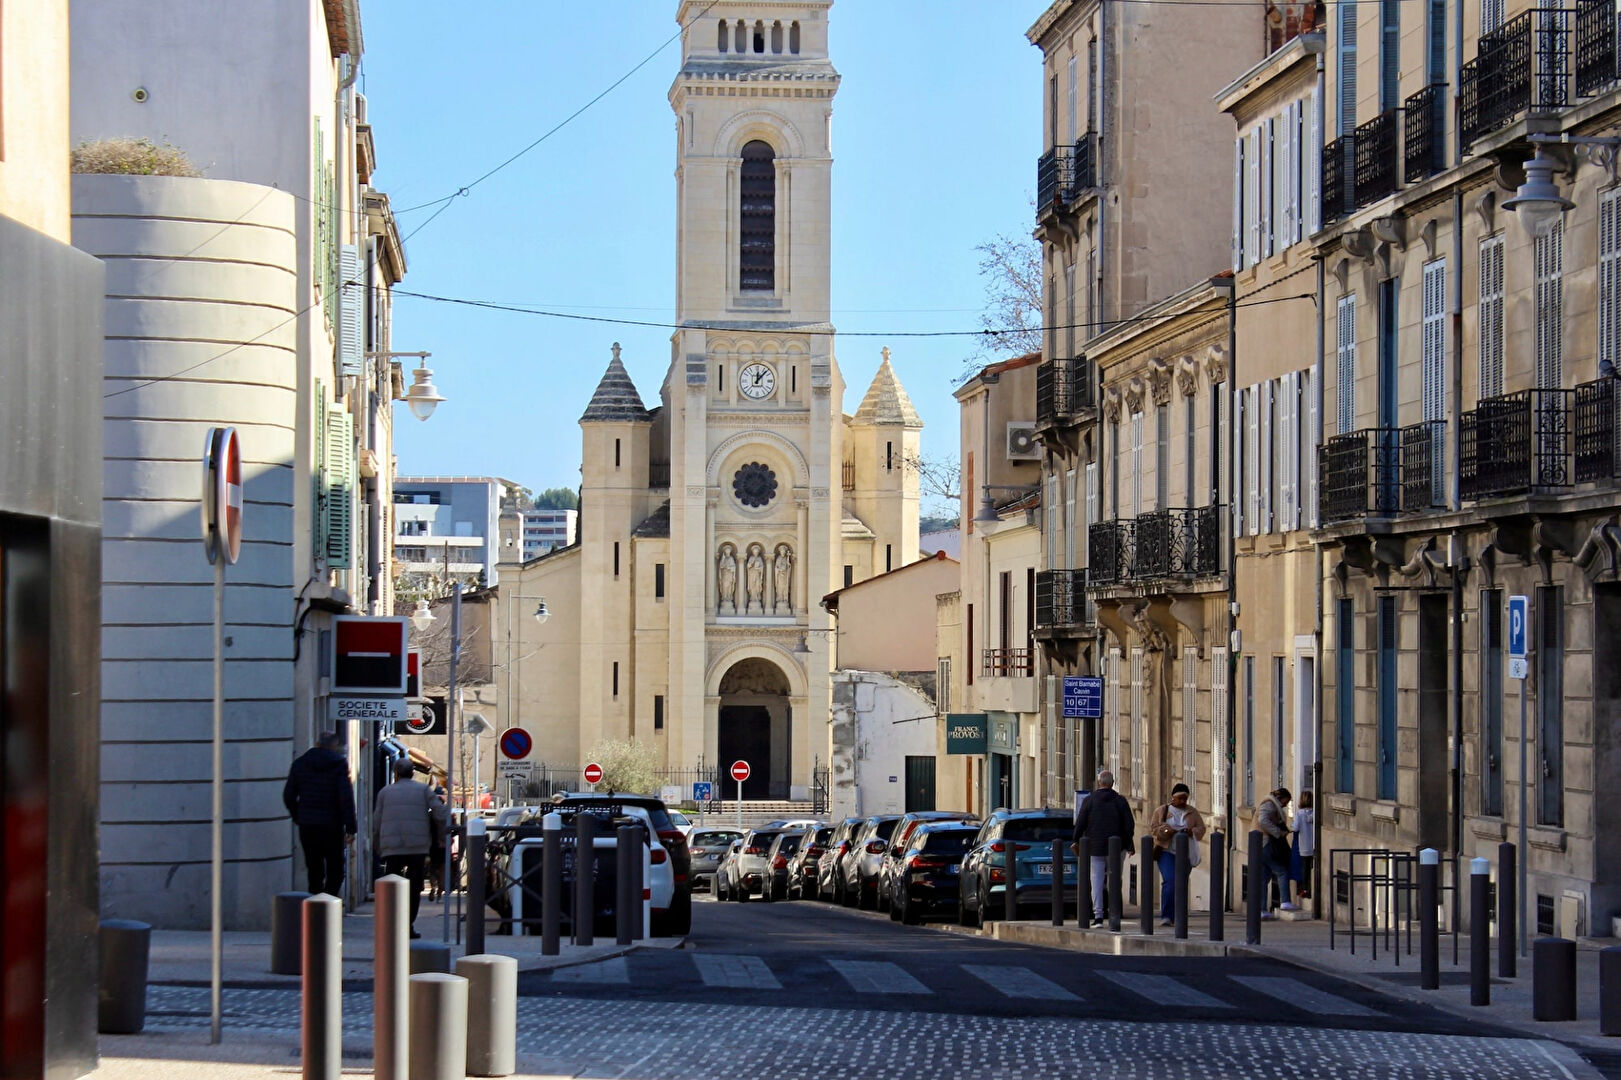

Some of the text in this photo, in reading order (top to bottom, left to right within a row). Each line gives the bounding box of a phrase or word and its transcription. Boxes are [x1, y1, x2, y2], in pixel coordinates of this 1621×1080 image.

[1513, 609, 1521, 645] P
[338, 701, 387, 709] SOCIETE
[1066, 698, 1087, 706] 10 67
[338, 710, 398, 718] GENERALE
[948, 731, 984, 739] PROVOST
